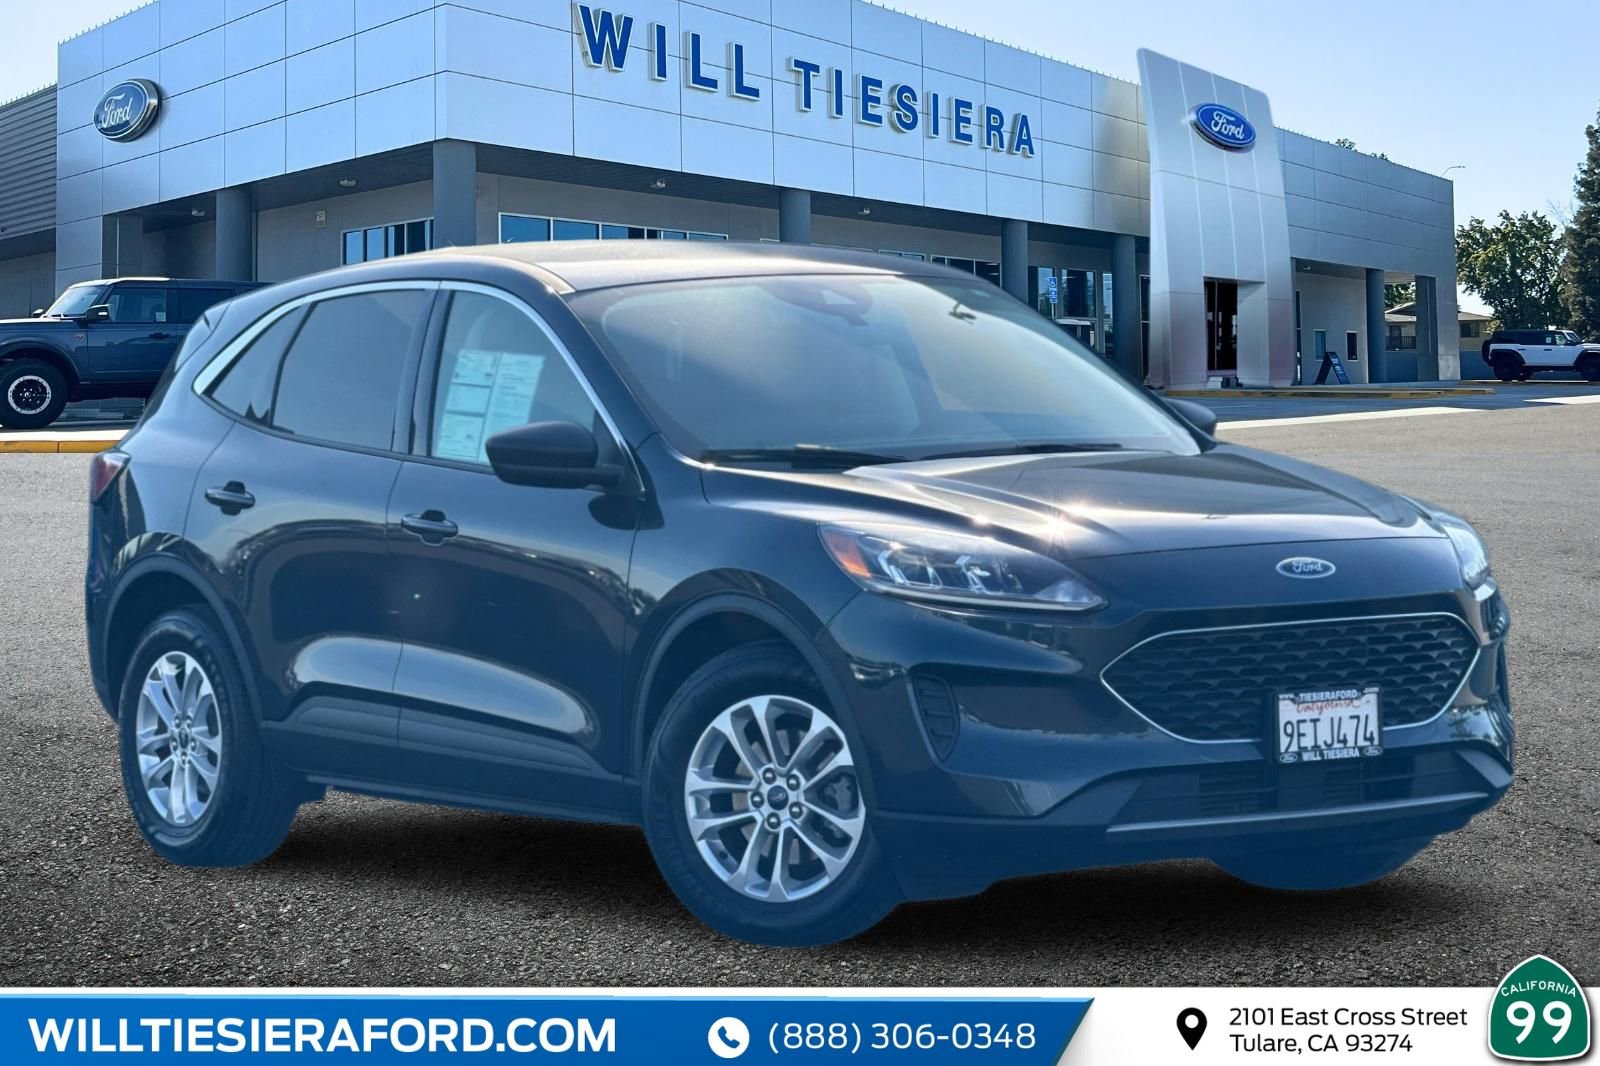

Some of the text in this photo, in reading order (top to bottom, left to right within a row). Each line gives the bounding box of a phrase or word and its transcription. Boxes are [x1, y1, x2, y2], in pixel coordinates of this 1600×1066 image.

[576, 3, 1036, 157] WILL TIESIERA
[101, 93, 134, 129] Ford
[1210, 110, 1245, 140] Ford
[1292, 559, 1324, 573] Ford
[1299, 690, 1358, 702] TIESIERAFORD
[1283, 714, 1375, 752] 9EIJ474
[1302, 751, 1322, 761] WILL
[1323, 747, 1360, 760] TIESIERA
